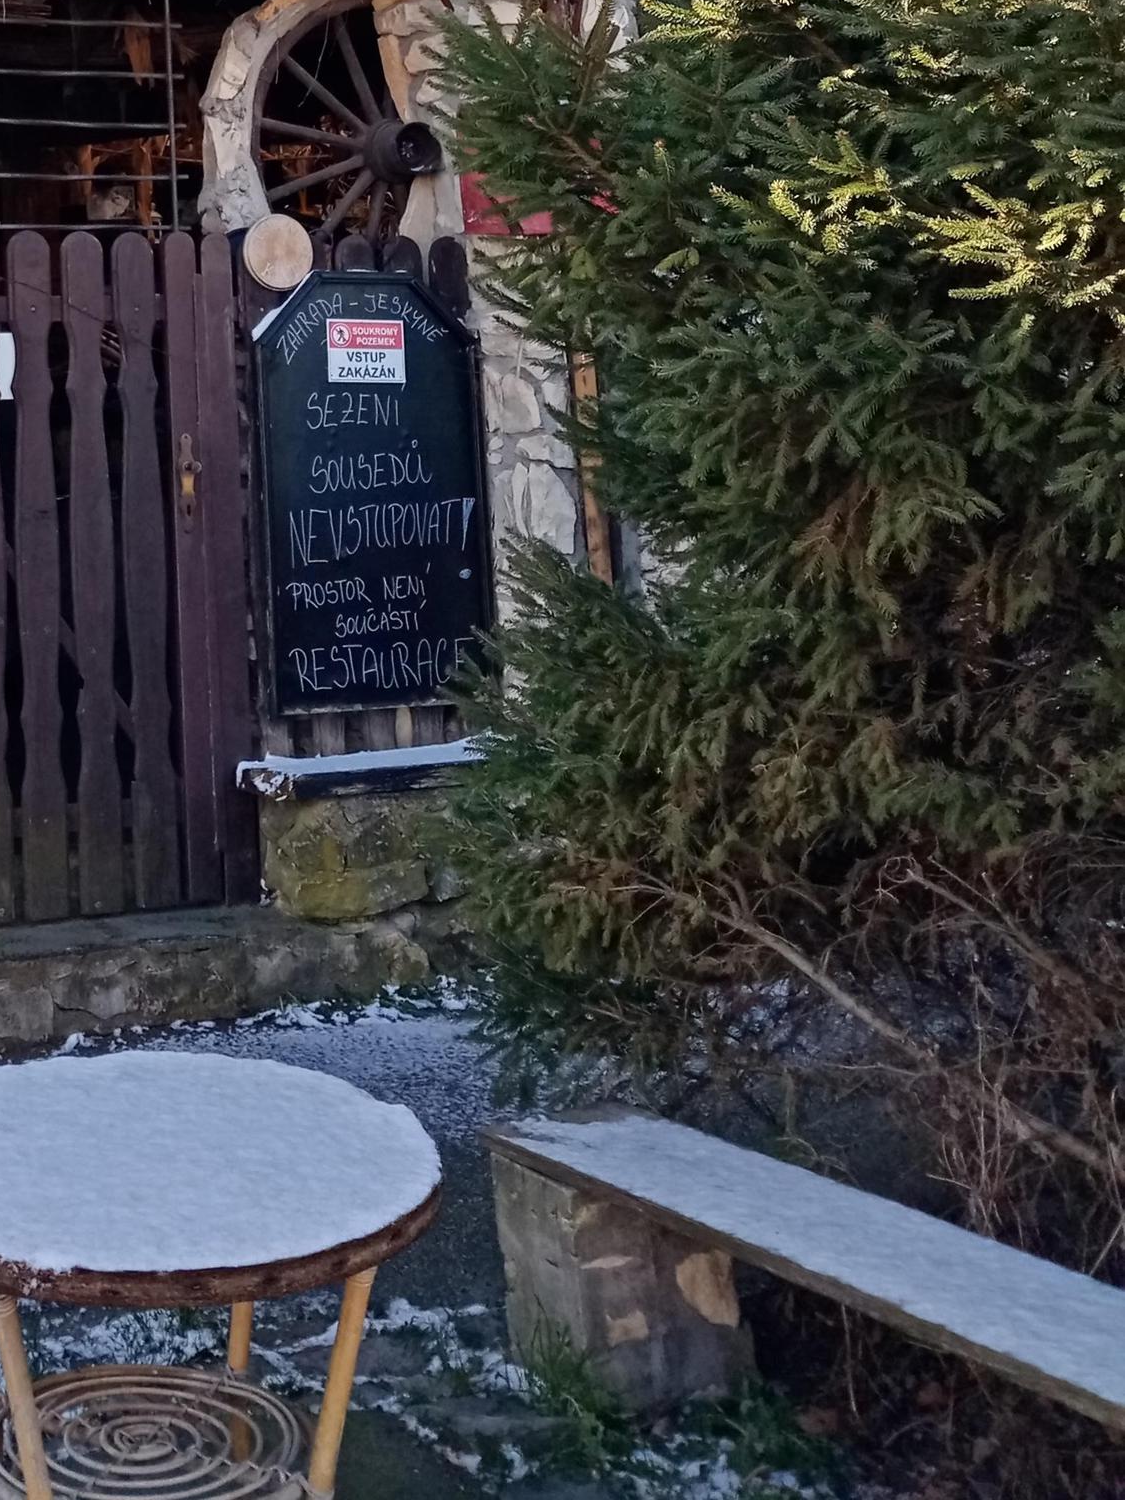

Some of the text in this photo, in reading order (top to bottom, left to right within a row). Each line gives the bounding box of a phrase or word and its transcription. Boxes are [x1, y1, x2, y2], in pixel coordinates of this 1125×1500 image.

[276, 292, 343, 365] ZAHRADA
[364, 292, 450, 343] JESKYNĚ
[352, 325, 399, 336] SOUKROMÝ
[356, 337, 396, 346] POZEMEK
[338, 364, 396, 379] ZAKÁZÁN
[346, 351, 387, 363] VSTUP
[309, 439, 433, 494] SOUSEDŮ
[285, 562, 431, 611] PROSTOR NENÍ
[334, 599, 427, 639] SOUČÁSTÍ
[288, 637, 475, 693] RESTAURACE
